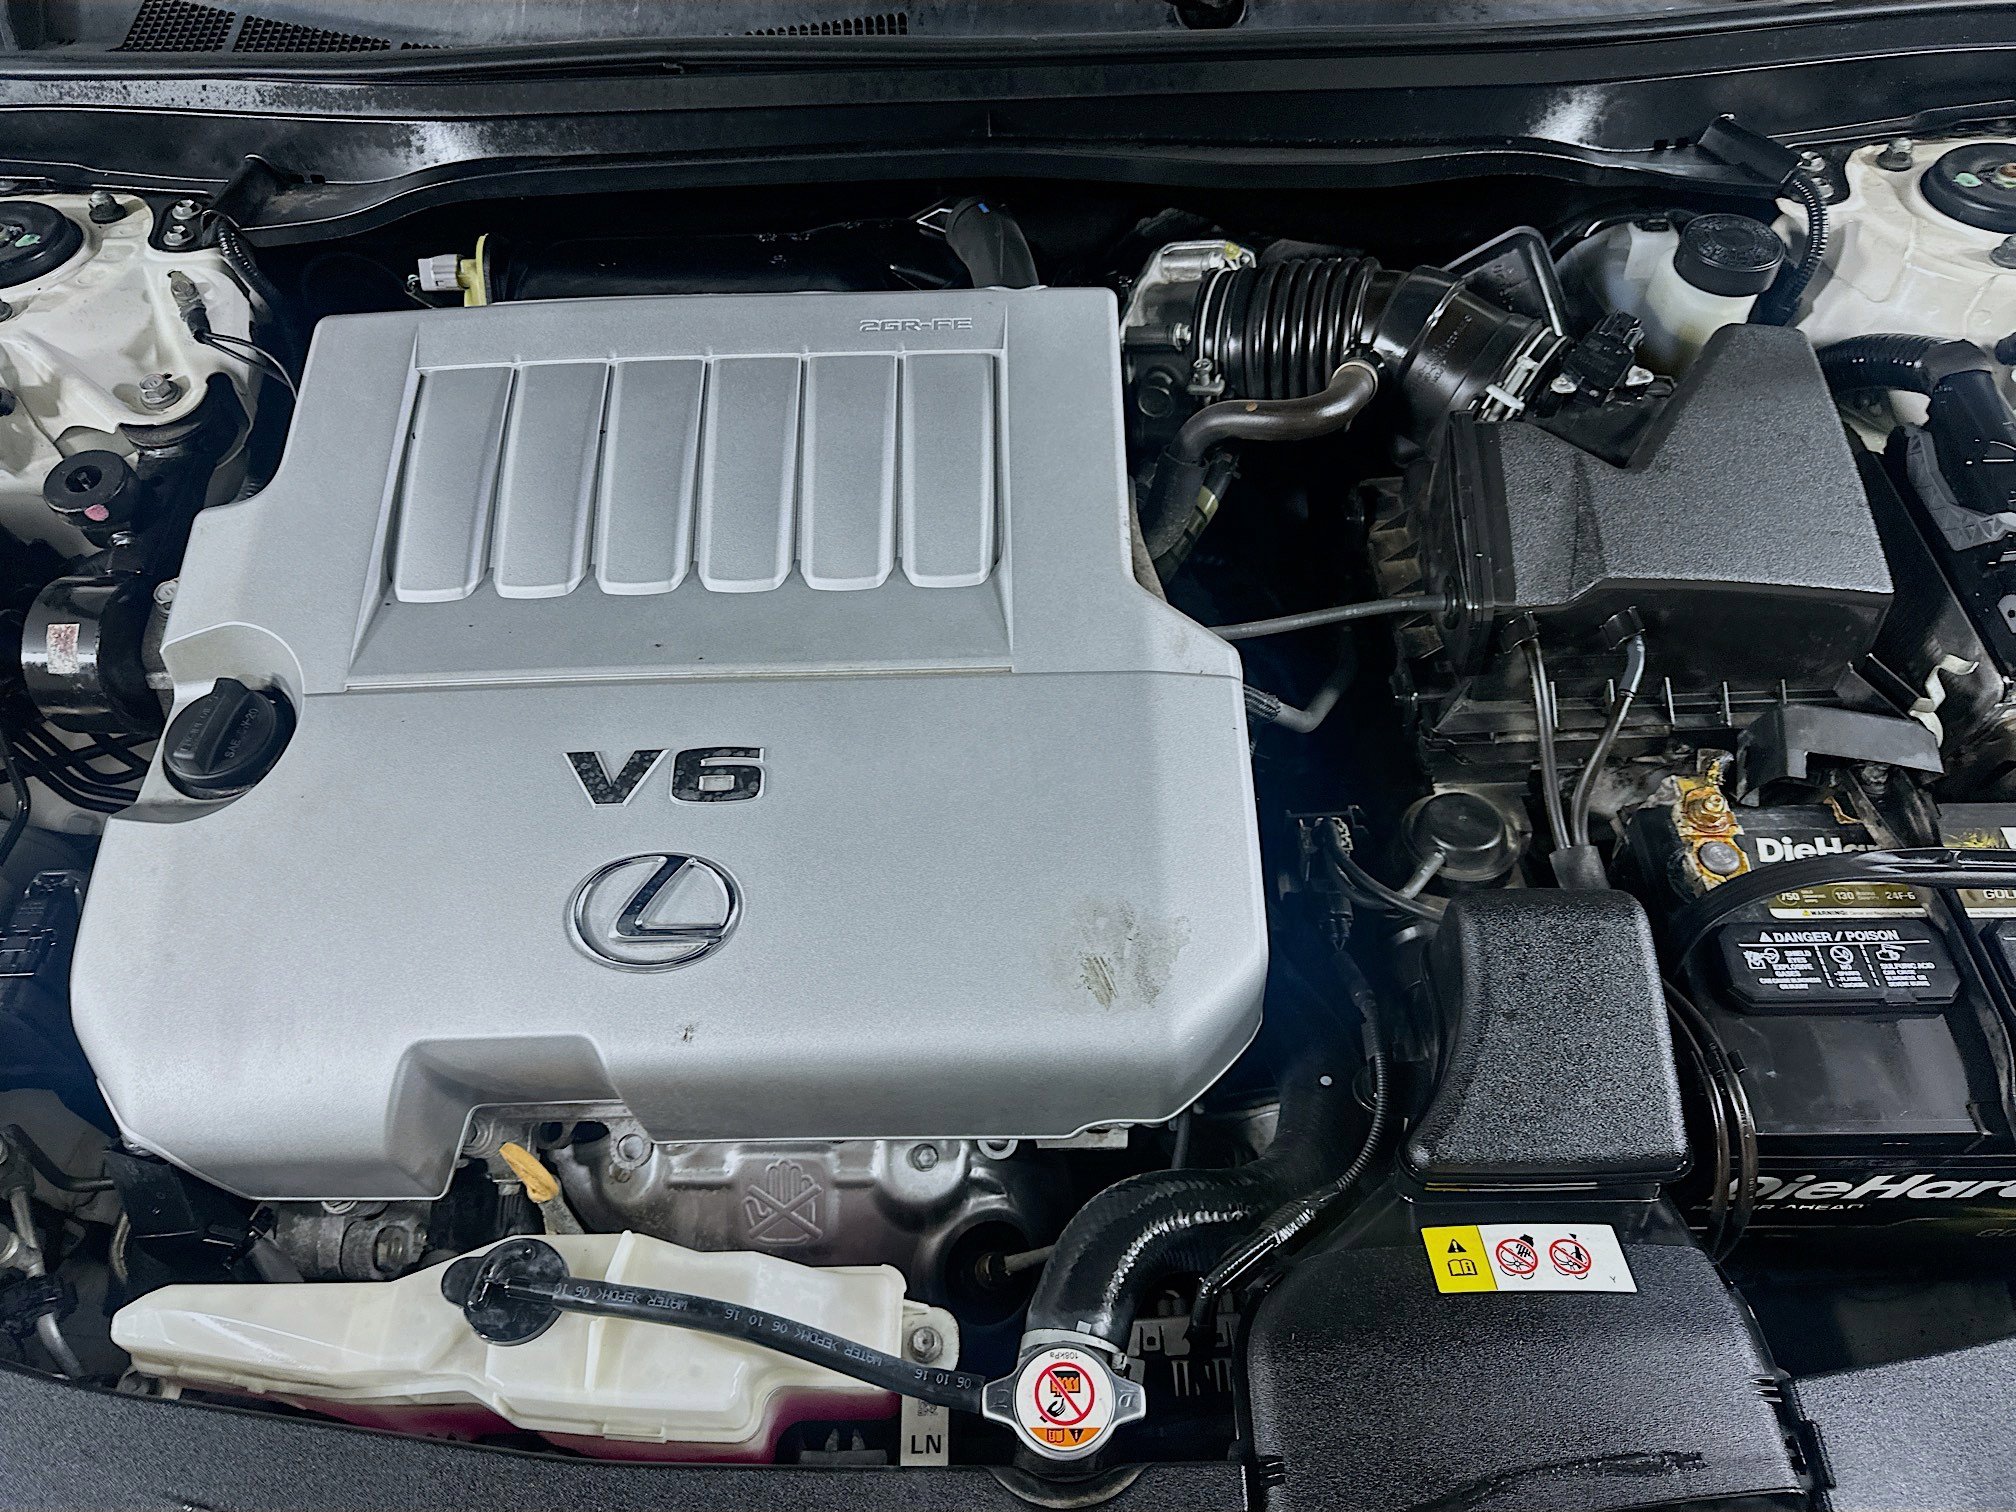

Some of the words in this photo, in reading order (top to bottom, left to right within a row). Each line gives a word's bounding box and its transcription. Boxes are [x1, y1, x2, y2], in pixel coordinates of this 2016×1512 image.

[860, 317, 972, 332] 2GR-FE
[562, 746, 766, 809] V6
[1835, 891, 1855, 900] 130
[1884, 891, 1916, 900] 24F-6
[1772, 931, 1833, 942] DANGER
[1844, 930, 1900, 942] POISON
[575, 1285, 590, 1297] 06
[646, 1298, 689, 1310] WATER
[724, 1308, 740, 1320] 16
[748, 1314, 763, 1327] 10
[771, 1321, 788, 1334] 06
[844, 1346, 883, 1367] WATER
[1049, 1351, 1079, 1359] 108kPa
[914, 1368, 928, 1381] 16
[936, 1372, 949, 1385] 10
[911, 1434, 942, 1454] LN
